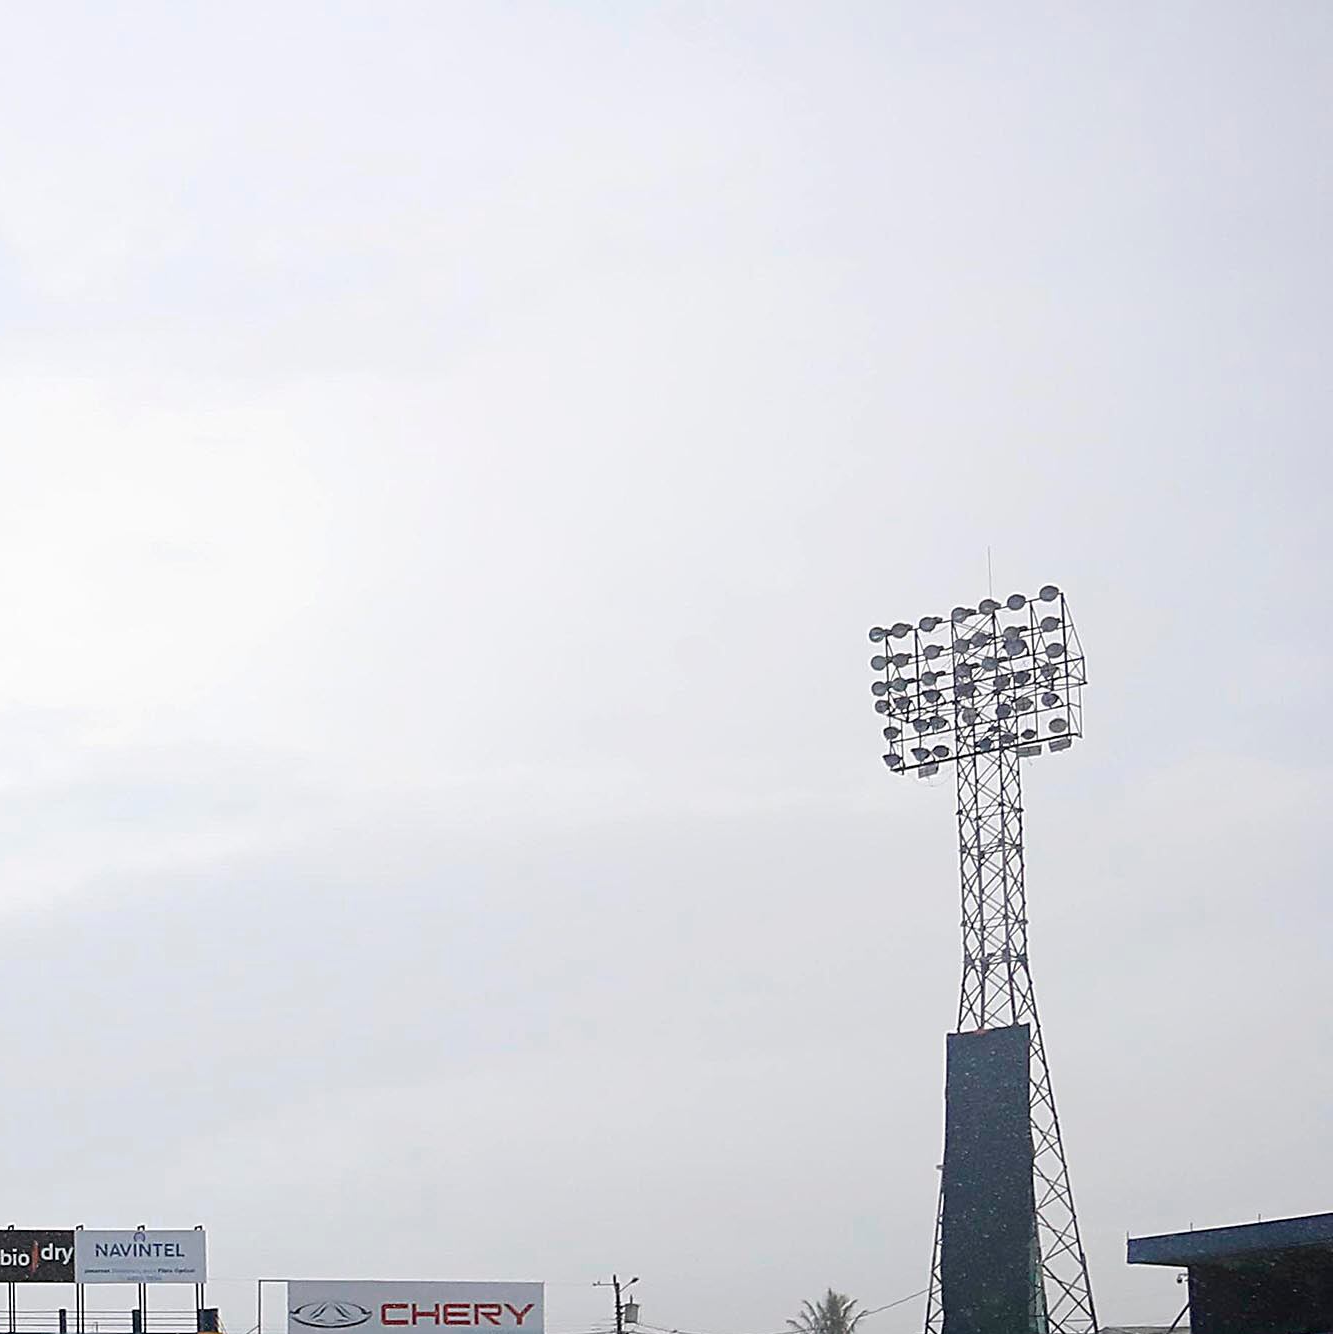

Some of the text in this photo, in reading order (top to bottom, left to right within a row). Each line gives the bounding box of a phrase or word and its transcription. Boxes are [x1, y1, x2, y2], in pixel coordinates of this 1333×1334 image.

[0, 1242, 74, 1267] bio dry
[95, 1243, 185, 1257] NAVINTEL
[381, 1303, 534, 1326] CHERY
